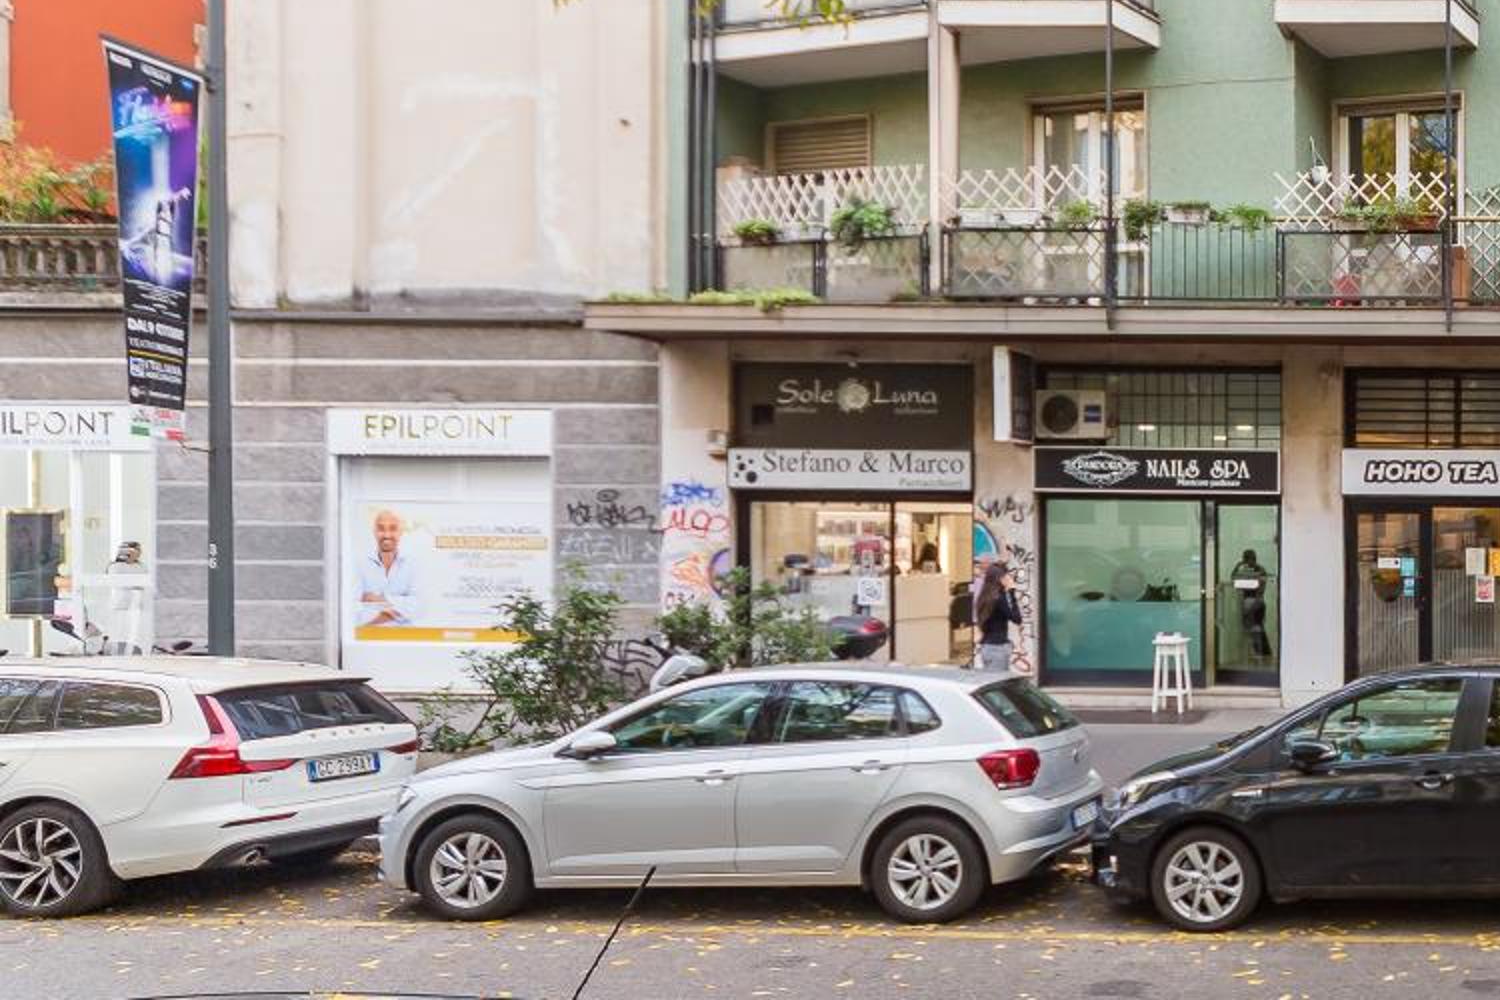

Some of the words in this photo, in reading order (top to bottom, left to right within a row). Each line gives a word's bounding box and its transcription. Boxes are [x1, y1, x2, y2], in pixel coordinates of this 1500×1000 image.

[776, 379, 833, 405] Sole
[872, 379, 938, 405] Luna
[364, 415, 512, 439] EPILPOINT
[762, 450, 849, 473] Stefano
[858, 452, 880, 473] &
[889, 452, 965, 474] Marco
[1146, 459, 1201, 479] NAILS
[1210, 459, 1250, 479] SPA
[1364, 459, 1443, 484] HOHO
[1448, 460, 1498, 484] TEA
